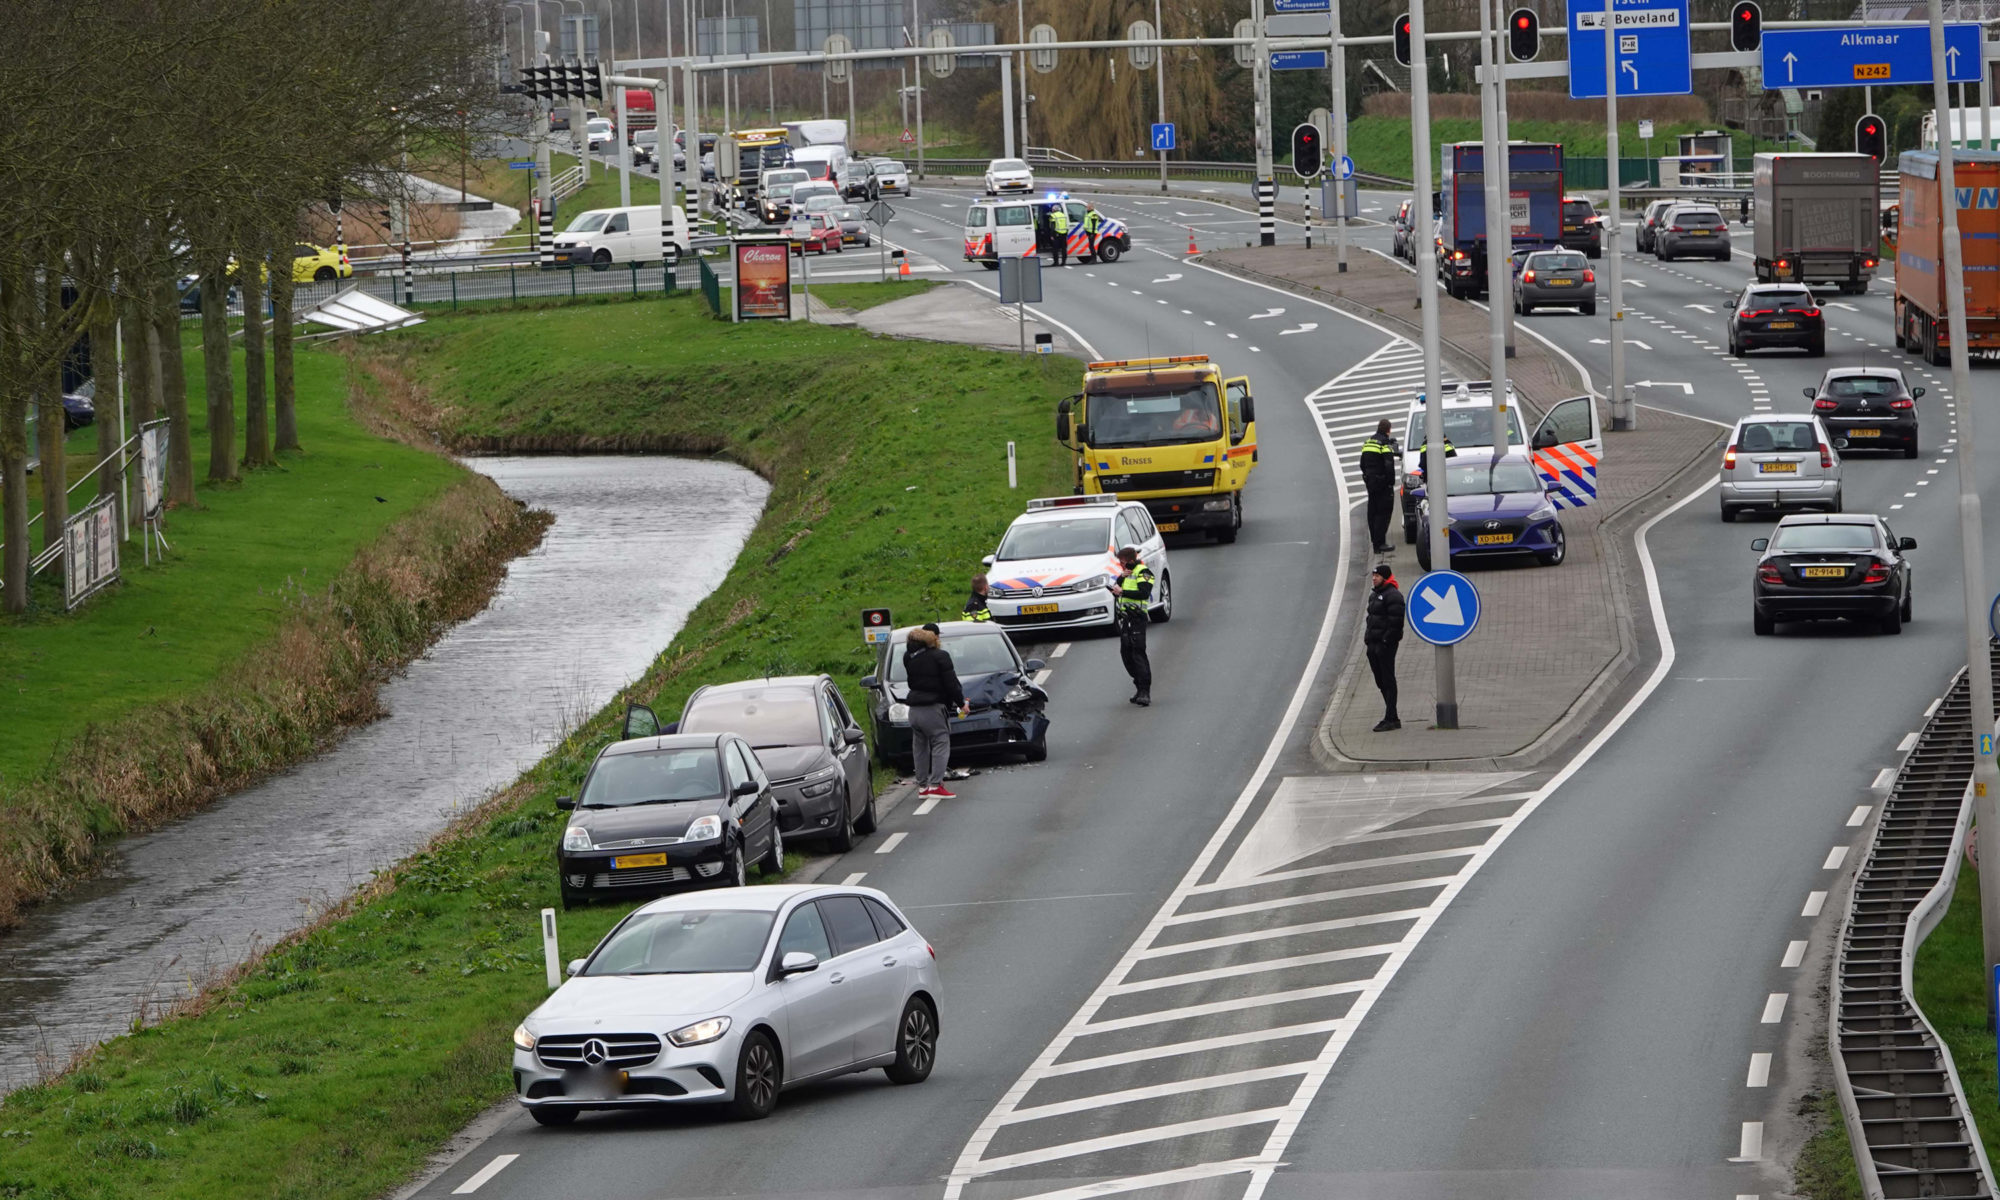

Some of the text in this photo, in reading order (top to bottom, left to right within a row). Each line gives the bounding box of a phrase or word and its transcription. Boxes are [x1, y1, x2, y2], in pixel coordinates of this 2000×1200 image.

[1615, 12, 1675, 25] Beveland
[1841, 33, 1899, 46] Alkmaar
[744, 249, 782, 264] Charon
[1194, 472, 1213, 480] LF
[1102, 478, 1128, 486] DAF
[1479, 535, 1512, 543] XD-344-F
[1808, 568, 1842, 576] HZ-914-B
[1023, 604, 1055, 614] KN-916-L
